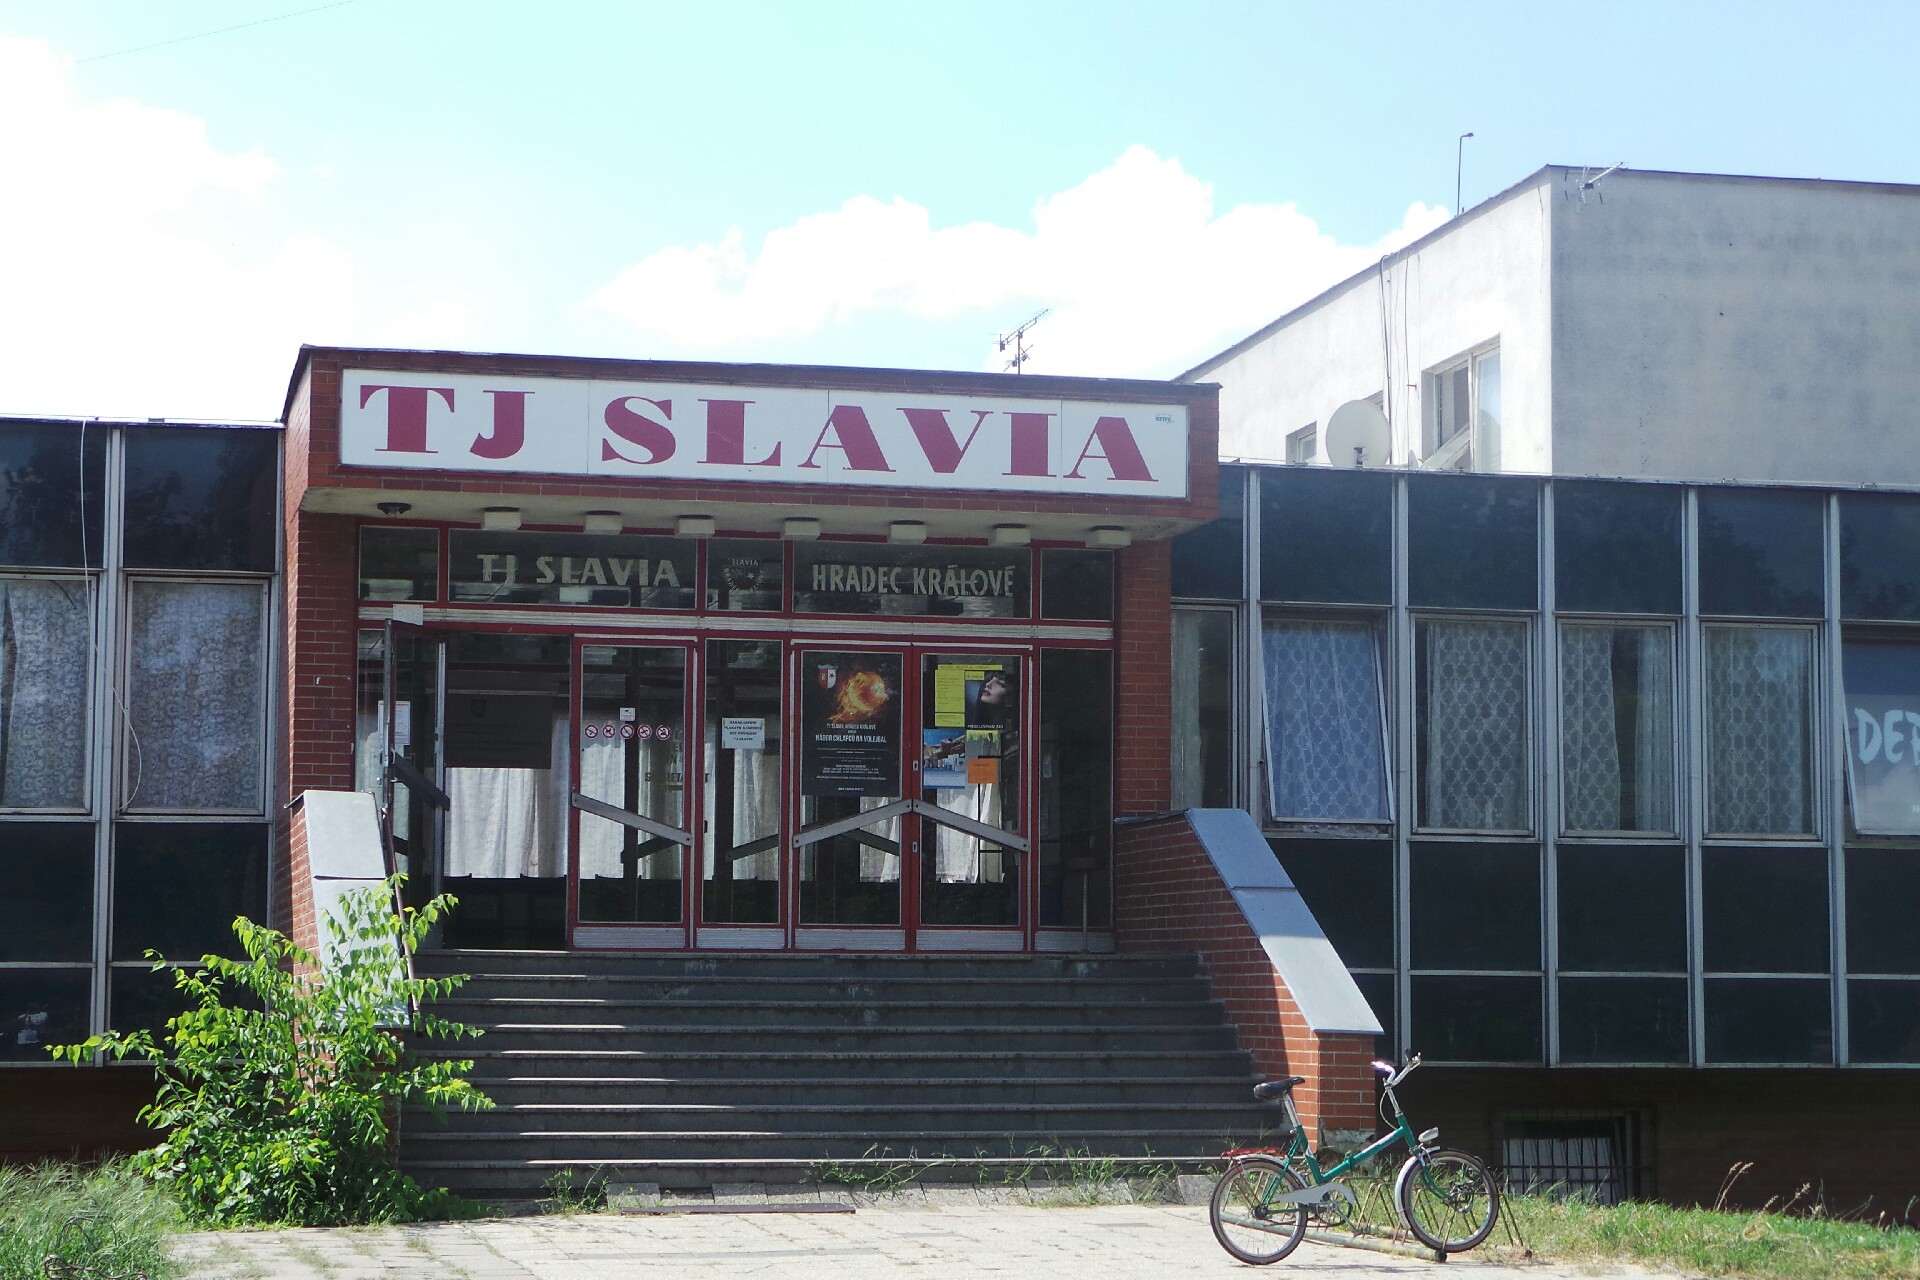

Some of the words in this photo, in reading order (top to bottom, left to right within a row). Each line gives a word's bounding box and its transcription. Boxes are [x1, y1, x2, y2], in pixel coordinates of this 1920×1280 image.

[360, 385, 535, 459] TJ
[602, 396, 1158, 482] SLAVIA
[536, 556, 680, 588] SLAVIA
[812, 564, 901, 594] HRADEC
[913, 564, 1016, 597] KRÁLOVÉ
